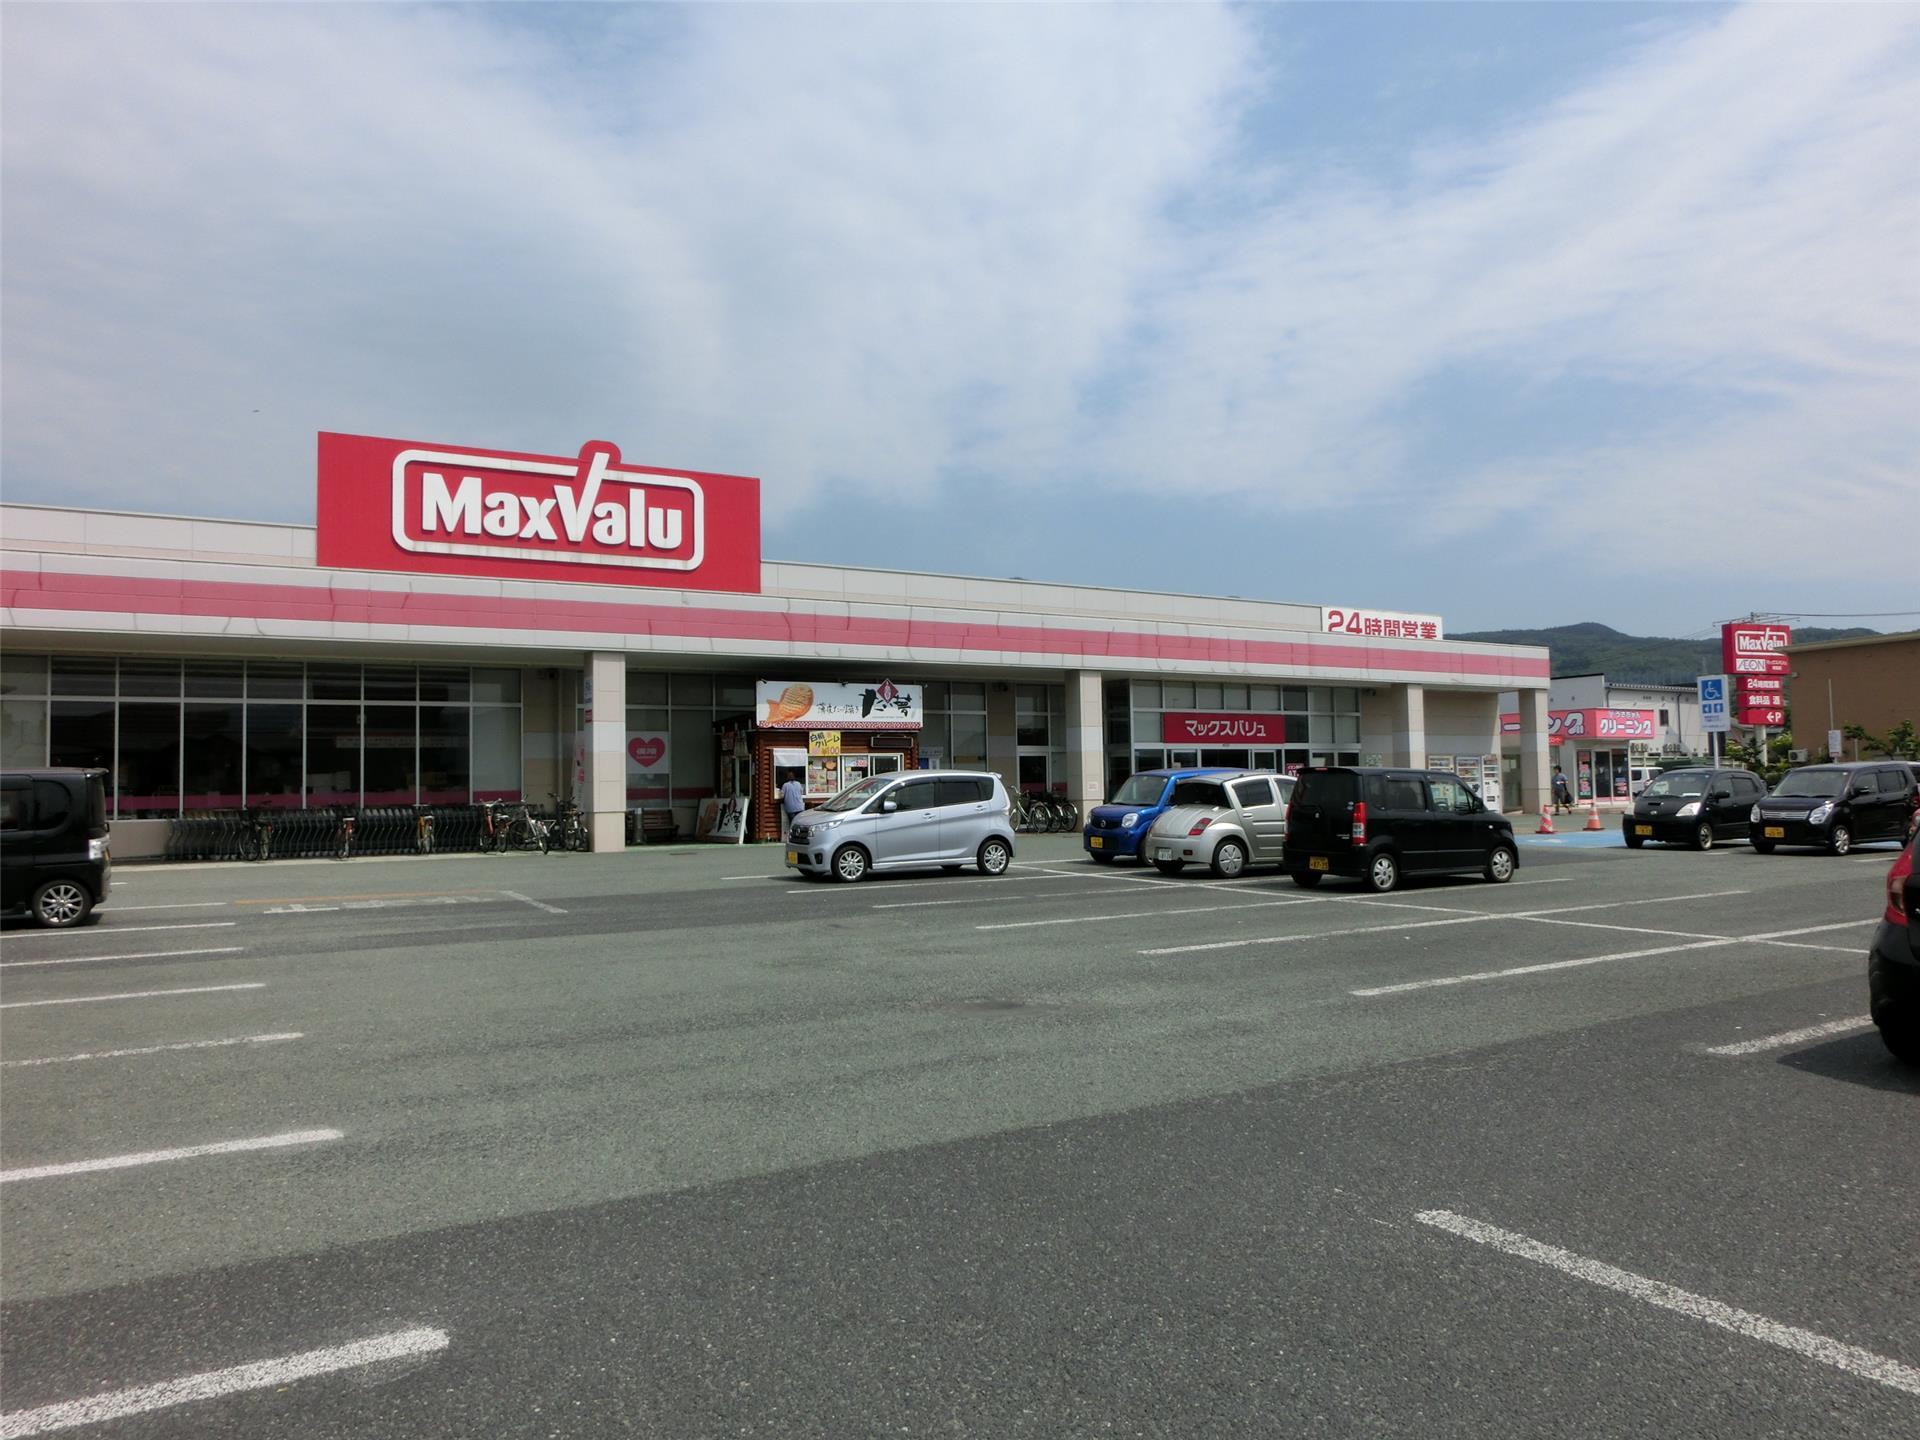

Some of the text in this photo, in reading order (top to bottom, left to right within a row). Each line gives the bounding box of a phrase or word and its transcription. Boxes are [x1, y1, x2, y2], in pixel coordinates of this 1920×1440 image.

[422, 452, 682, 549] MaxValu
[1328, 609, 1437, 639] 24時間営業
[1185, 719, 1266, 737] マックスバリュ
[1600, 718, 1652, 735] クリーニング
